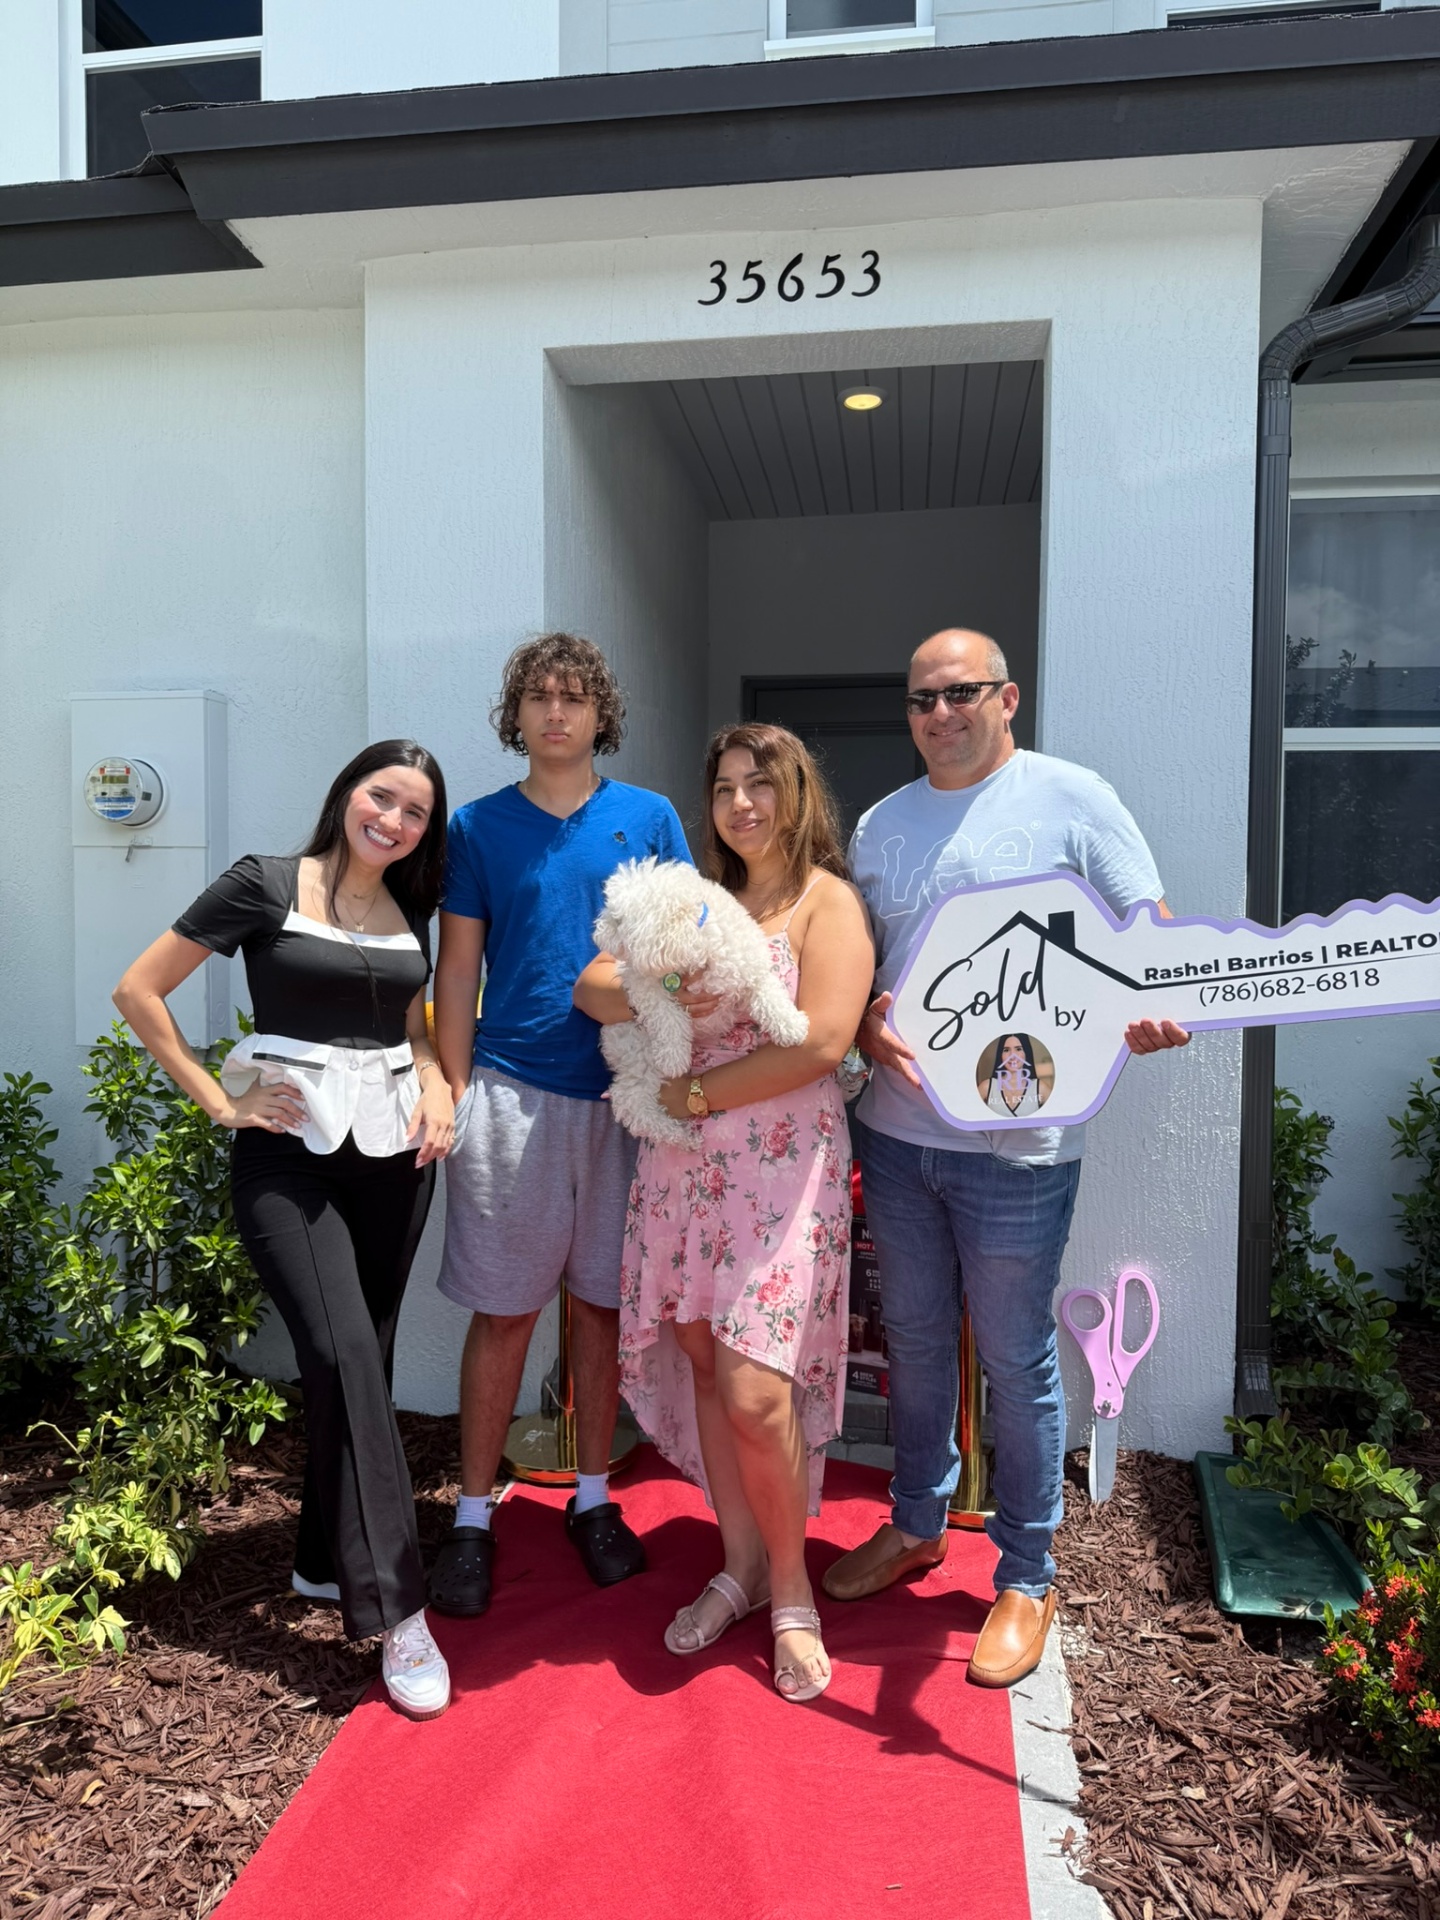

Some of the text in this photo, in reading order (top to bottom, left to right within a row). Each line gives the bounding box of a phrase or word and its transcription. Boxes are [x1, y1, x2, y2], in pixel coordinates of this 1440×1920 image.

[697, 249, 881, 306] 35653
[1144, 958, 1220, 981] Rashel
[1227, 950, 1314, 972] Barrios
[1336, 932, 1440, 959] REALTO
[923, 933, 1047, 1052] Sold
[1199, 968, 1380, 1007] (786)682-6818
[1054, 1005, 1087, 1031] by
[995, 1068, 1033, 1092] RB
[988, 1094, 1043, 1105] REAL ESTATE
[852, 1370, 859, 1380] 4
